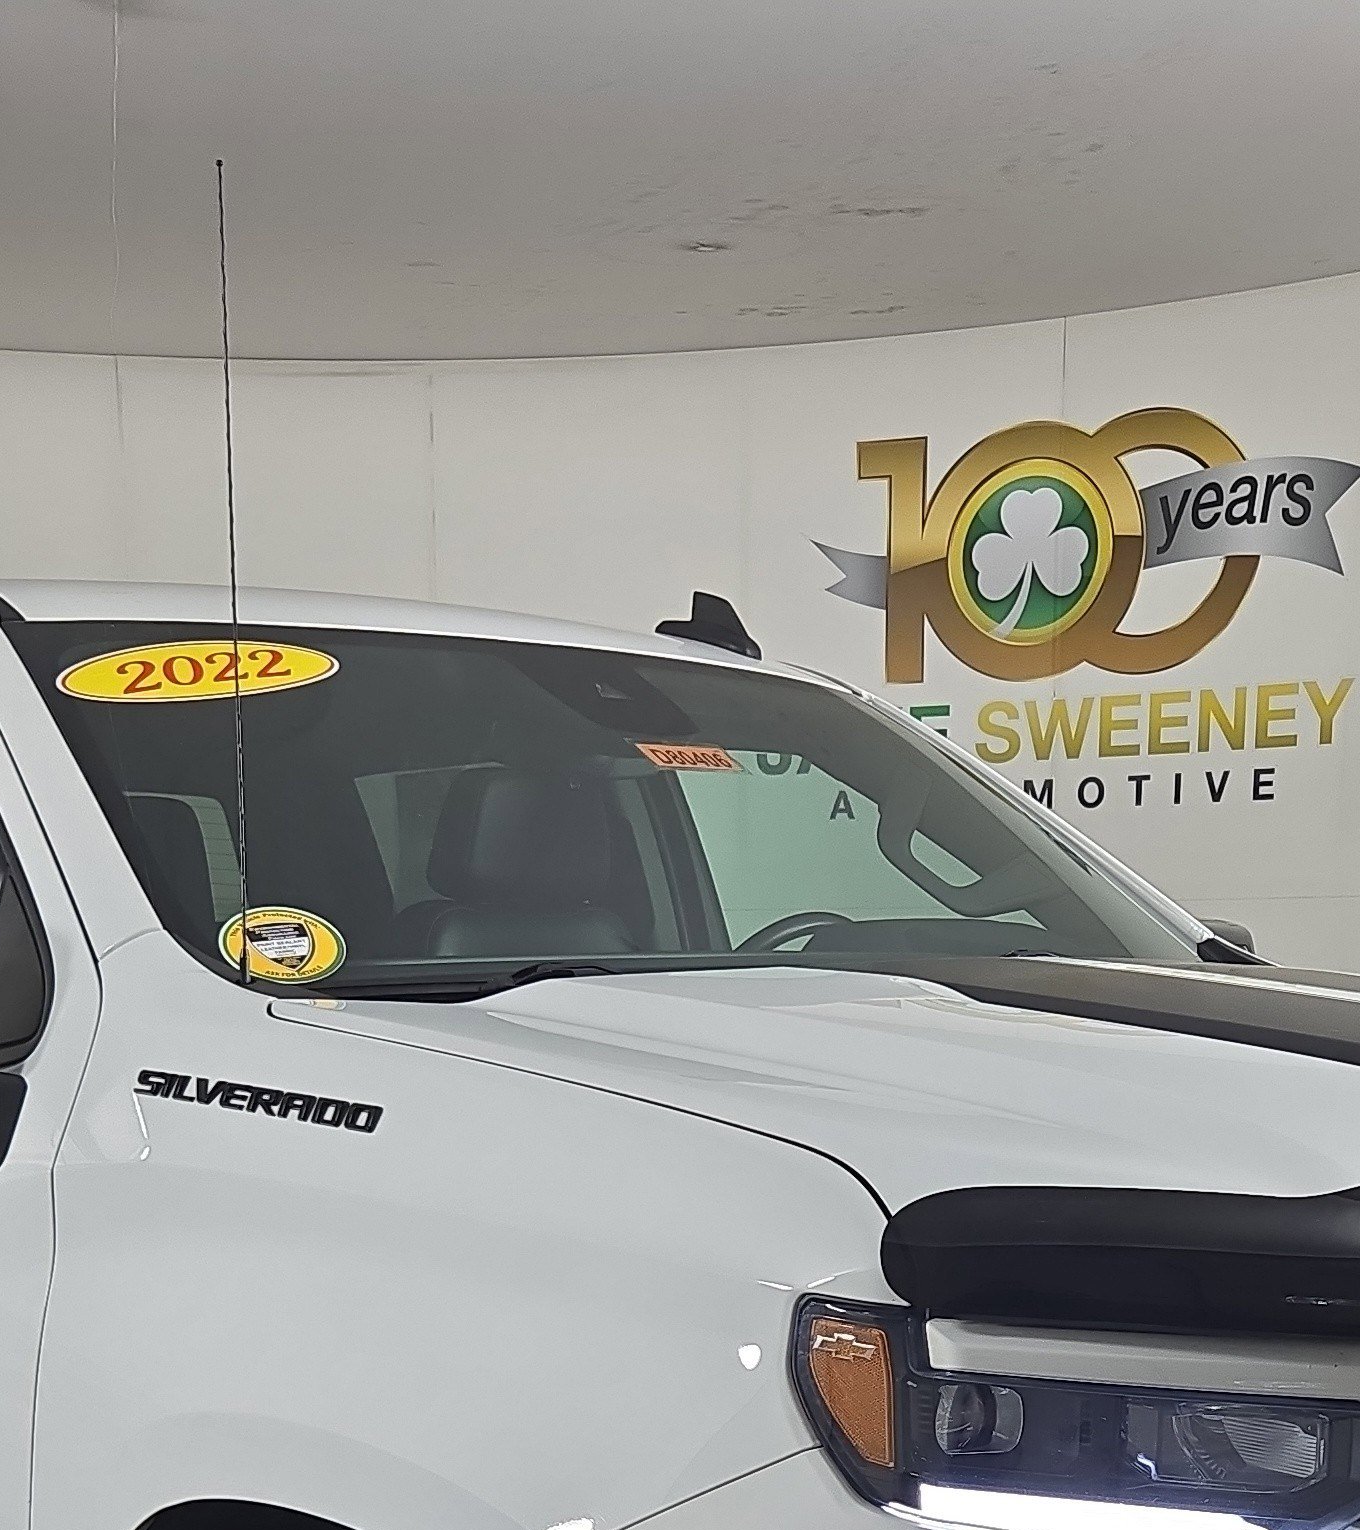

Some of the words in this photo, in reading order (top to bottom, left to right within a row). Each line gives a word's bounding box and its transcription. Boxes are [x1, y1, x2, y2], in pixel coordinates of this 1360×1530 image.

[856, 407, 1262, 684] 100
[1156, 470, 1315, 554] years
[116, 648, 292, 695] 2022
[974, 677, 1356, 764] SWEENEY
[648, 748, 733, 769] D80406
[134, 1069, 383, 1134] SILVERADO
